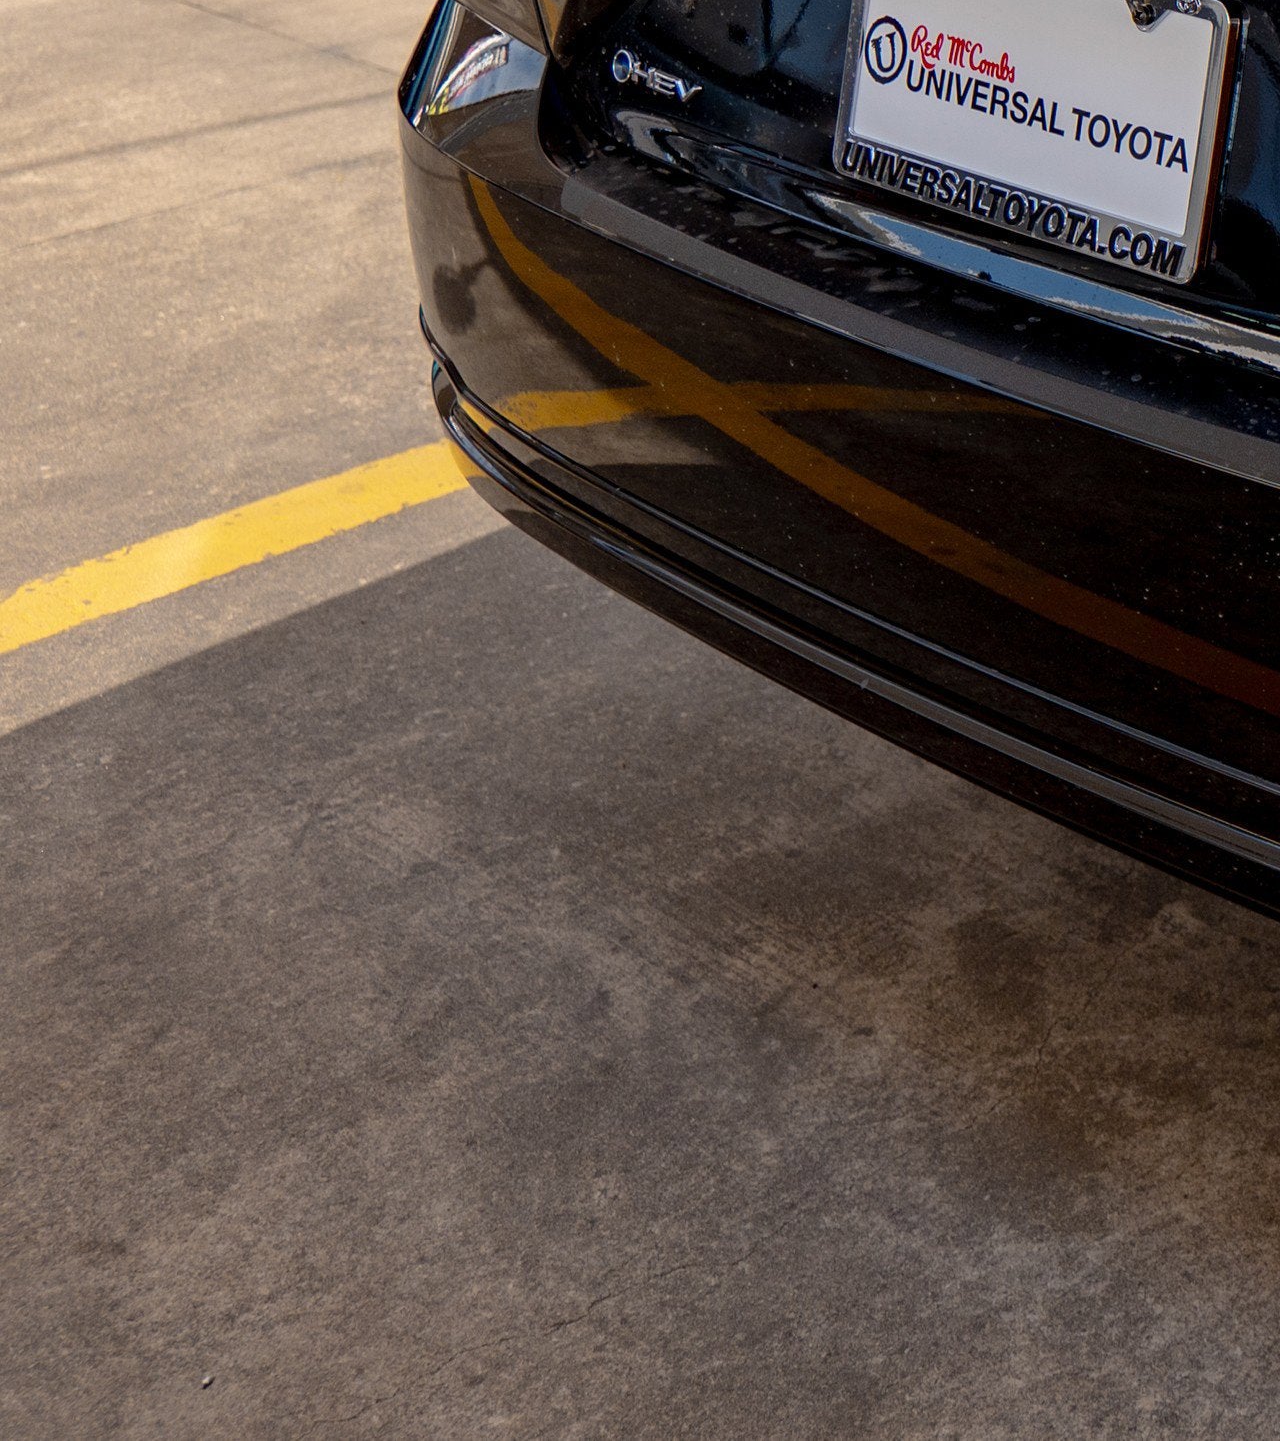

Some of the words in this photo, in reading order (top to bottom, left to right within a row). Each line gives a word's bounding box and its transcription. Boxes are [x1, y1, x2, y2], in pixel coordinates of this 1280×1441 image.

[910, 24, 944, 69] Red
[906, 59, 1066, 137] UNIVERSAL
[1071, 107, 1190, 173] TOYOTA
[841, 140, 1188, 277] UNIVERSALTOYOTA.COM
